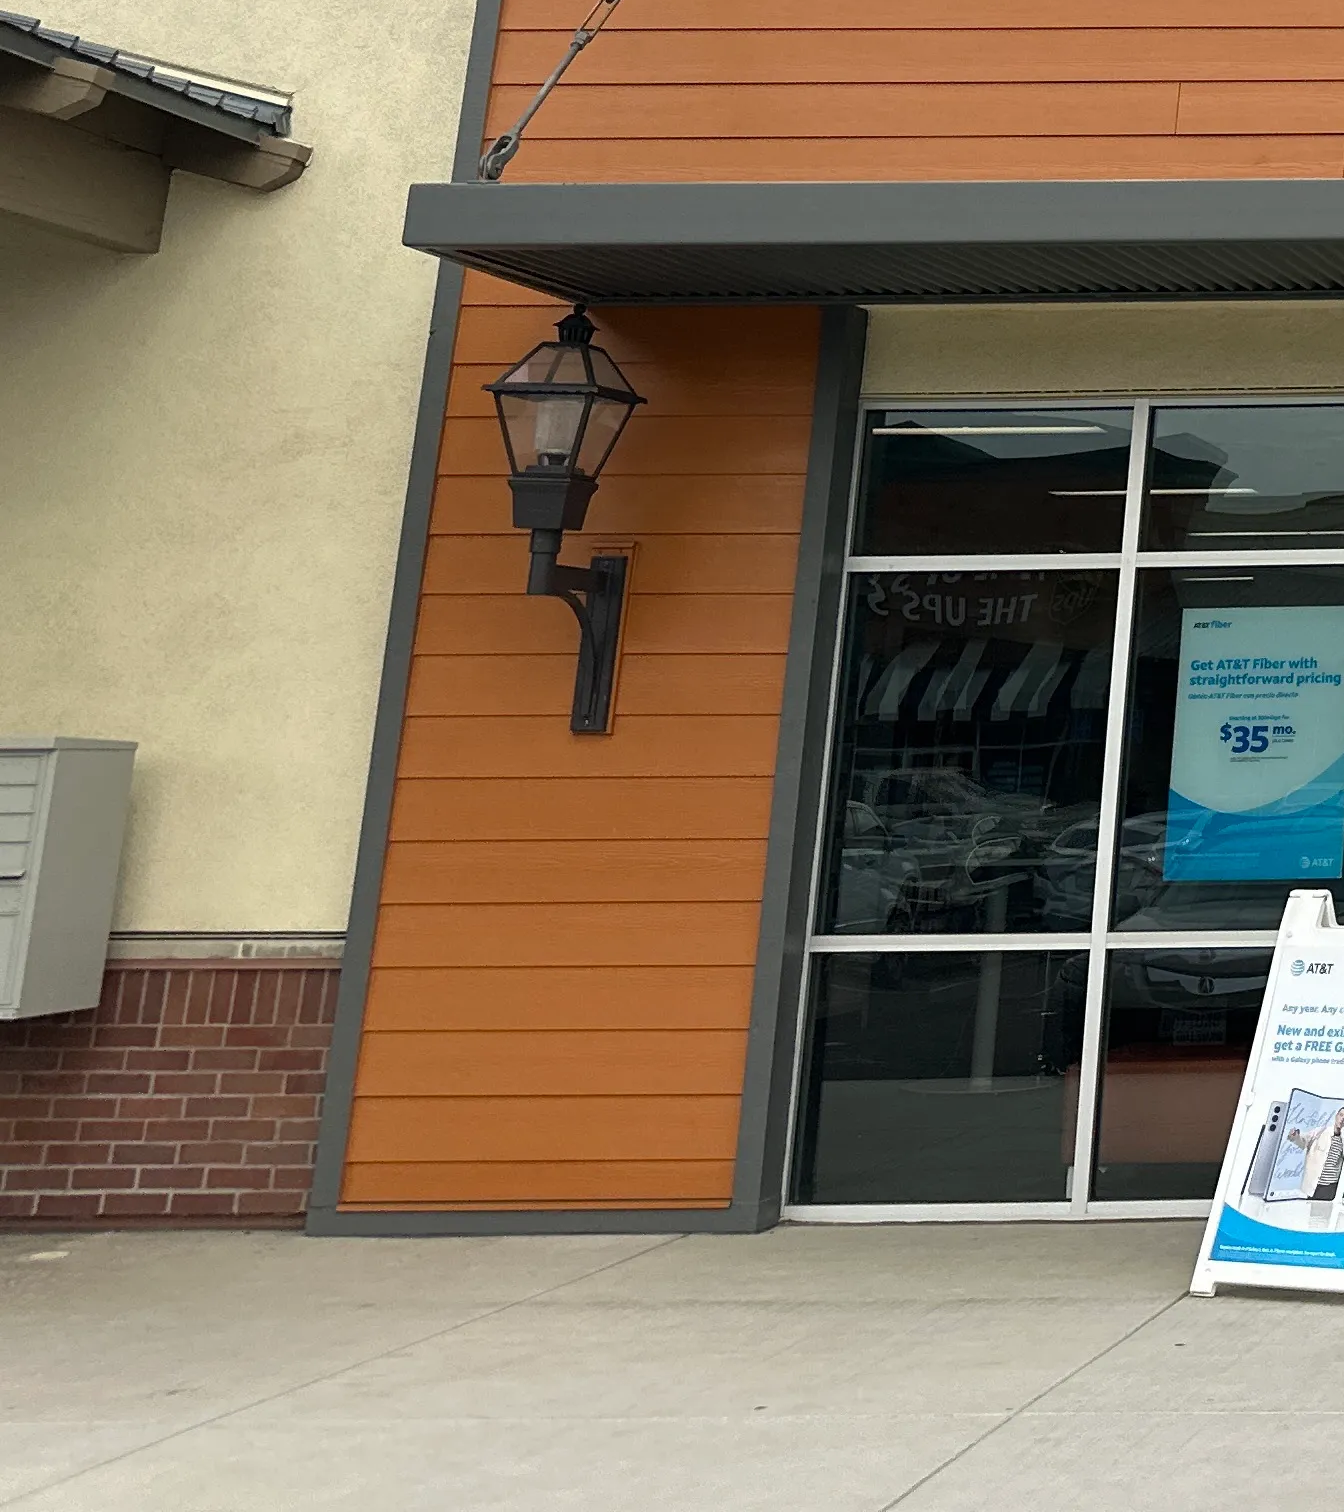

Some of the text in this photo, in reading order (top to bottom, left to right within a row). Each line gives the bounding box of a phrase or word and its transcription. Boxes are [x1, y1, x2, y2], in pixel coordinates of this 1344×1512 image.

[1190, 656, 1318, 671] Get AT&T Fiber with
[1189, 671, 1342, 688] straightforward pricing
[1220, 722, 1297, 753] $35 mo.
[1311, 858, 1334, 867] AT&T
[1306, 963, 1335, 975] AT&T
[1282, 1004, 1299, 1014] Any
[1321, 1004, 1338, 1015] Any
[1276, 1024, 1302, 1037] New
[1303, 1026, 1325, 1038] and
[1273, 1040, 1294, 1053] get
[1295, 1043, 1303, 1052] a
[1304, 1040, 1333, 1053] FREE
